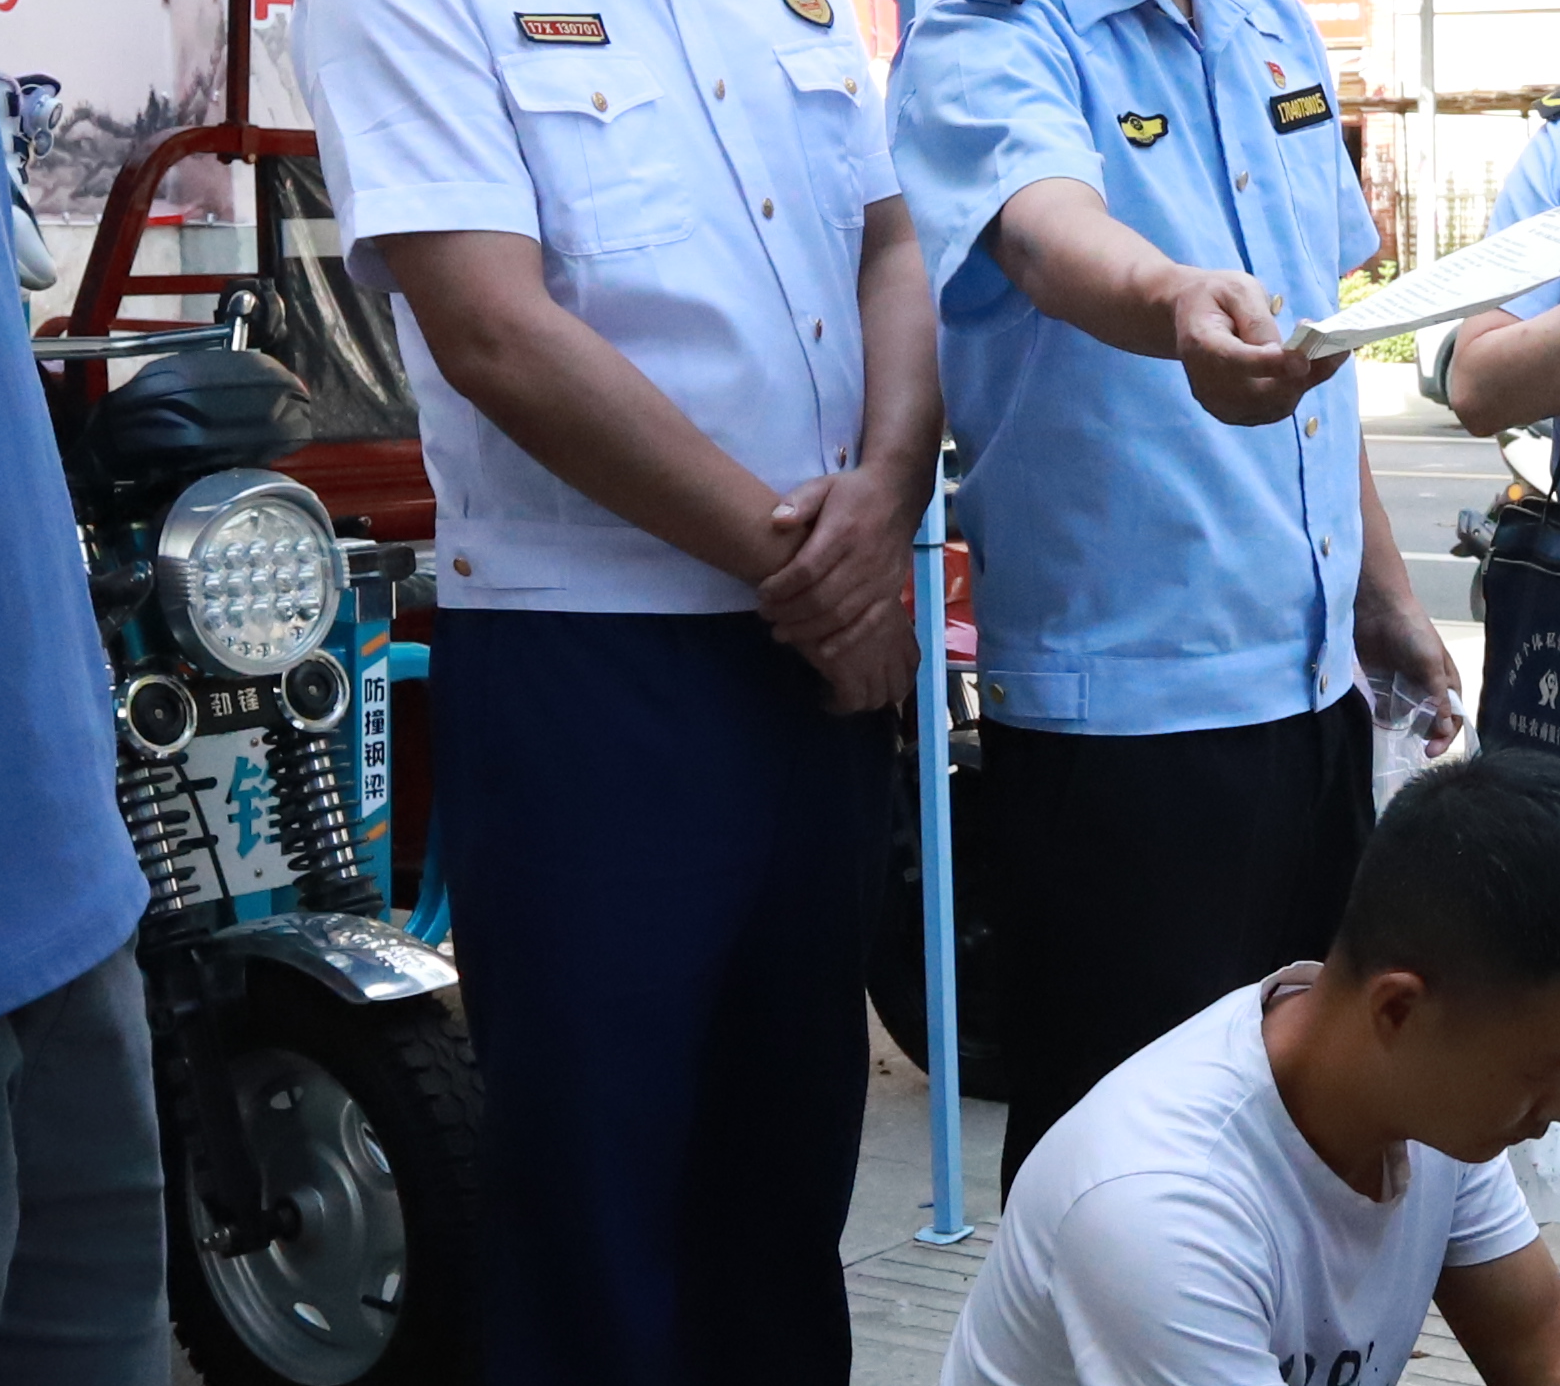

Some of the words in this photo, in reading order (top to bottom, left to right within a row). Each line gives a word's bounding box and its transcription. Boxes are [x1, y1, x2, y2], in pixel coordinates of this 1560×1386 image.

[554, 22, 600, 36] 130701
[364, 677, 386, 801] 防撞钢梁
